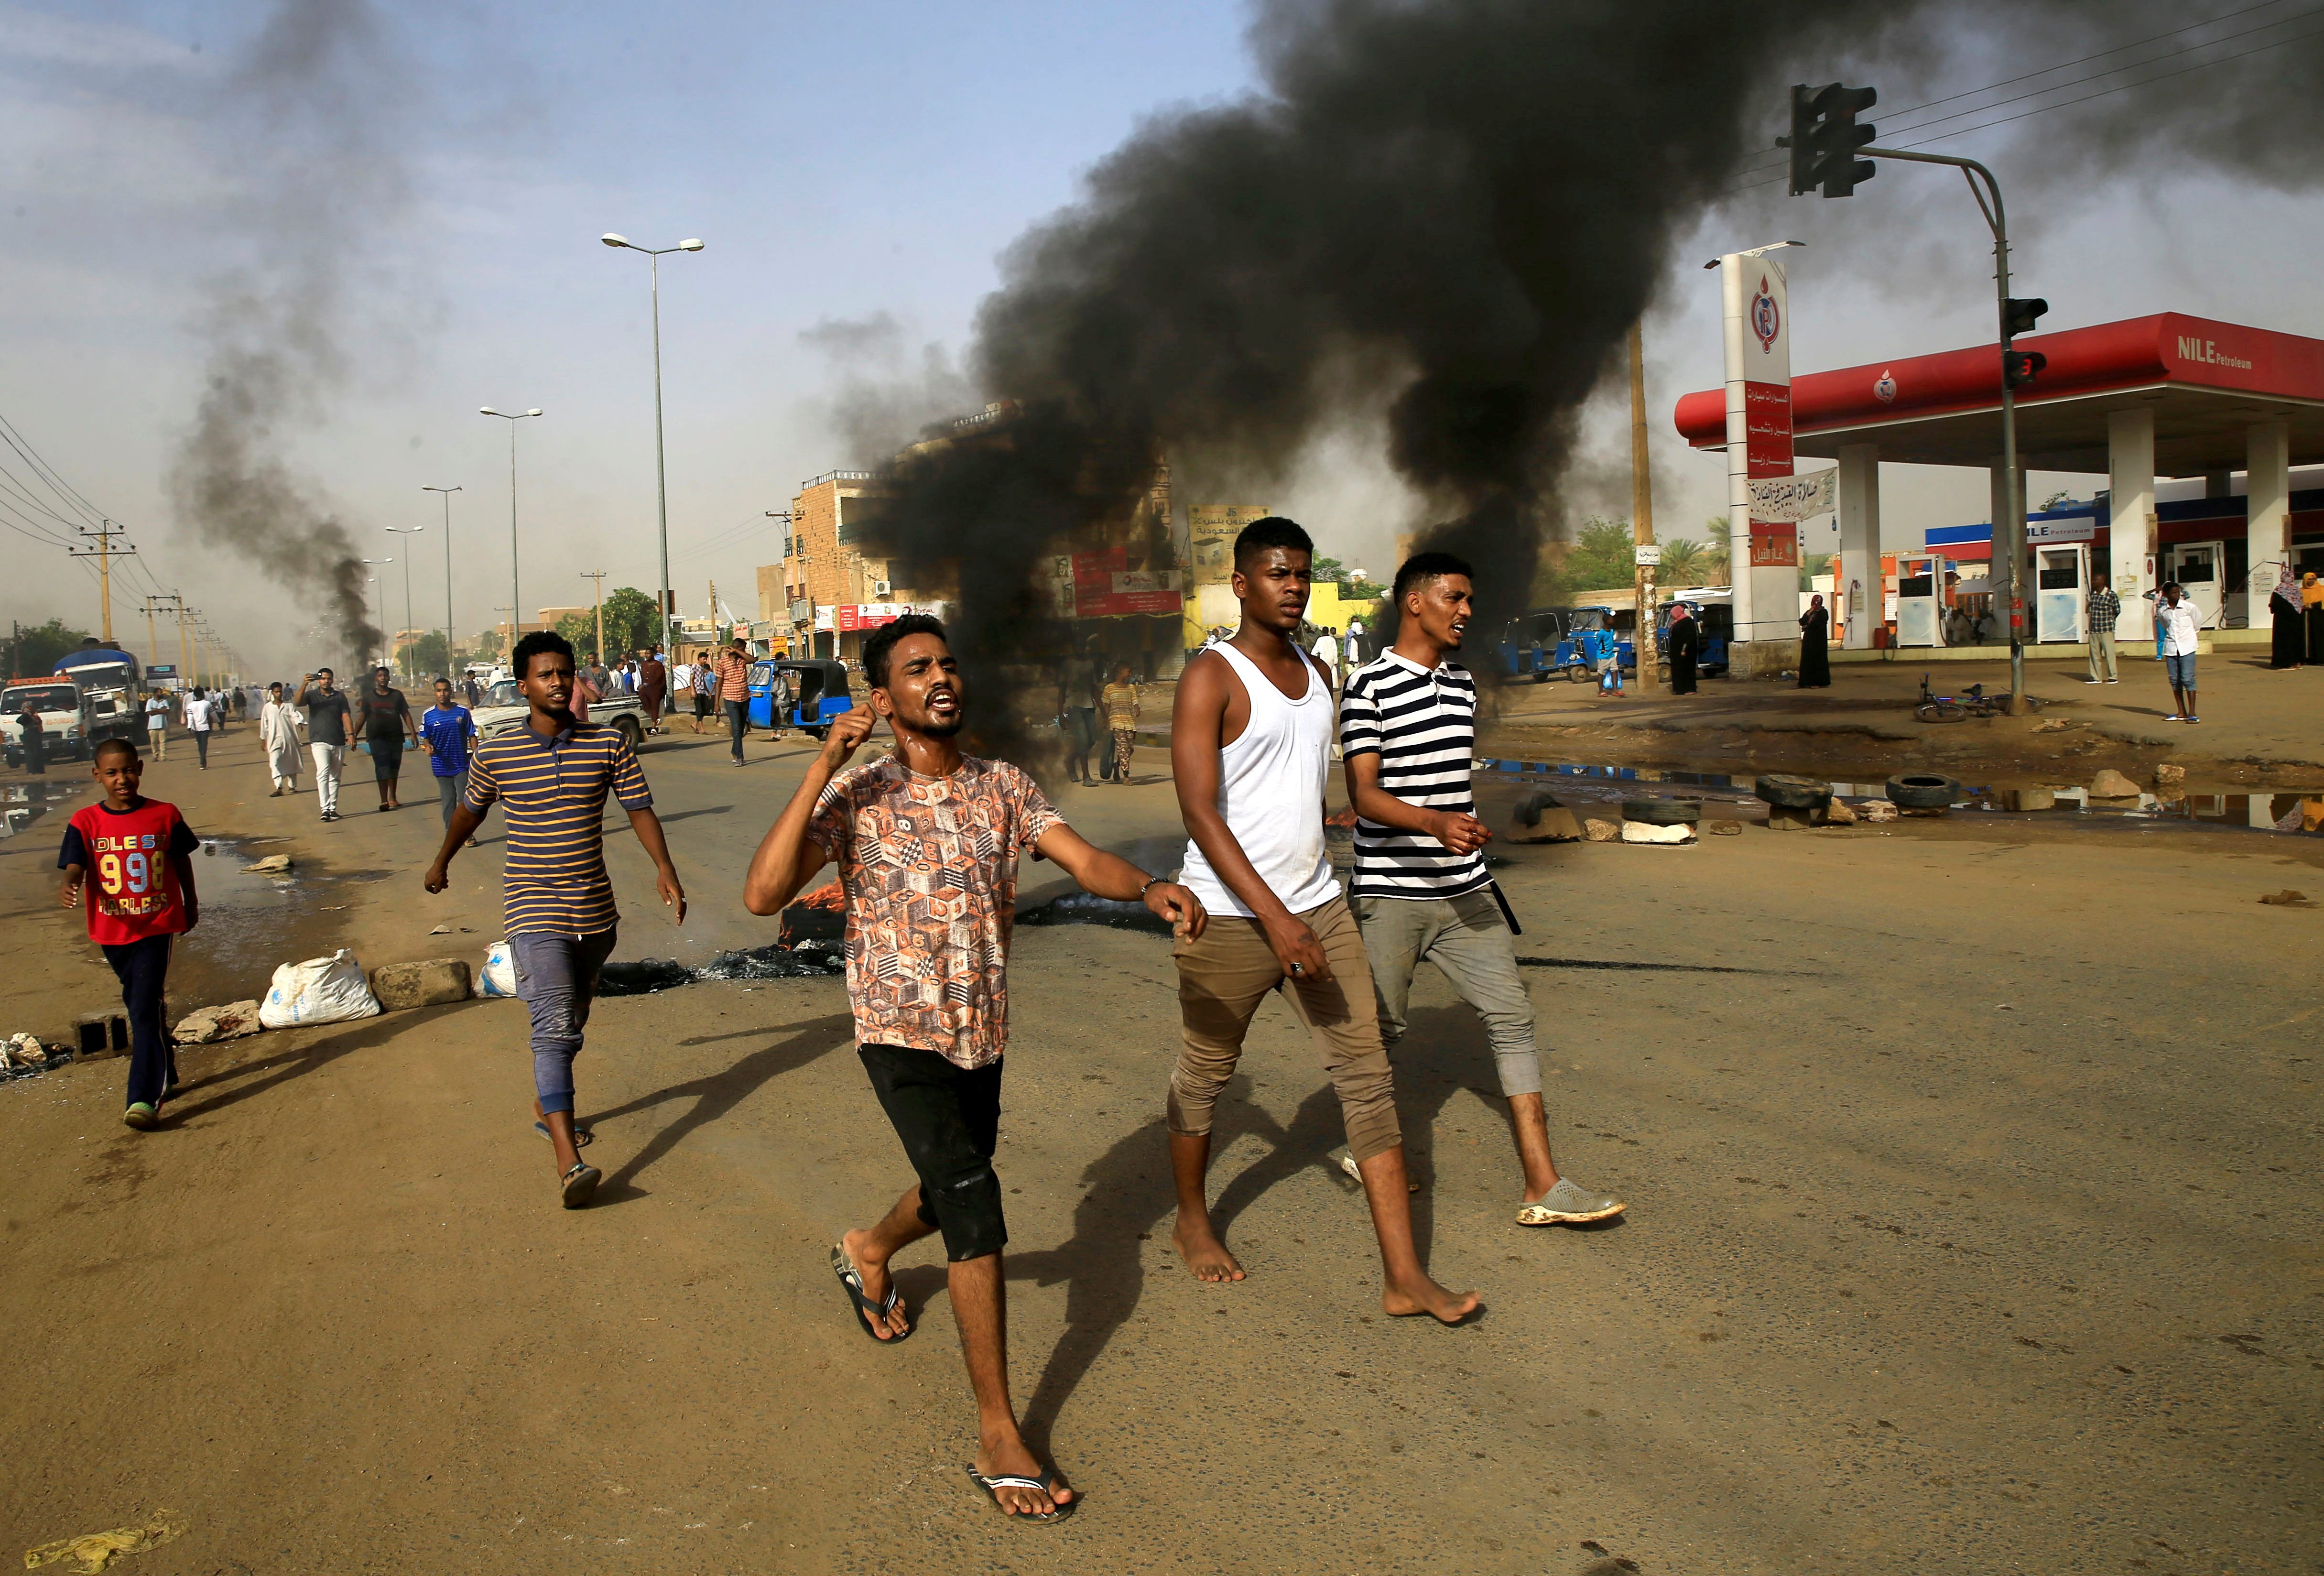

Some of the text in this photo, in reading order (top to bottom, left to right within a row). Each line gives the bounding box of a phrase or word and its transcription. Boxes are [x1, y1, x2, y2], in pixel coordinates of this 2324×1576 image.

[2178, 335, 2252, 370] NILE Petroleum
[2021, 358, 2032, 375] 3
[1196, 526, 1240, 535] السعودية
[2027, 527, 2049, 537] ILE
[1753, 547, 1770, 563] النيل
[99, 850, 164, 894] 998
